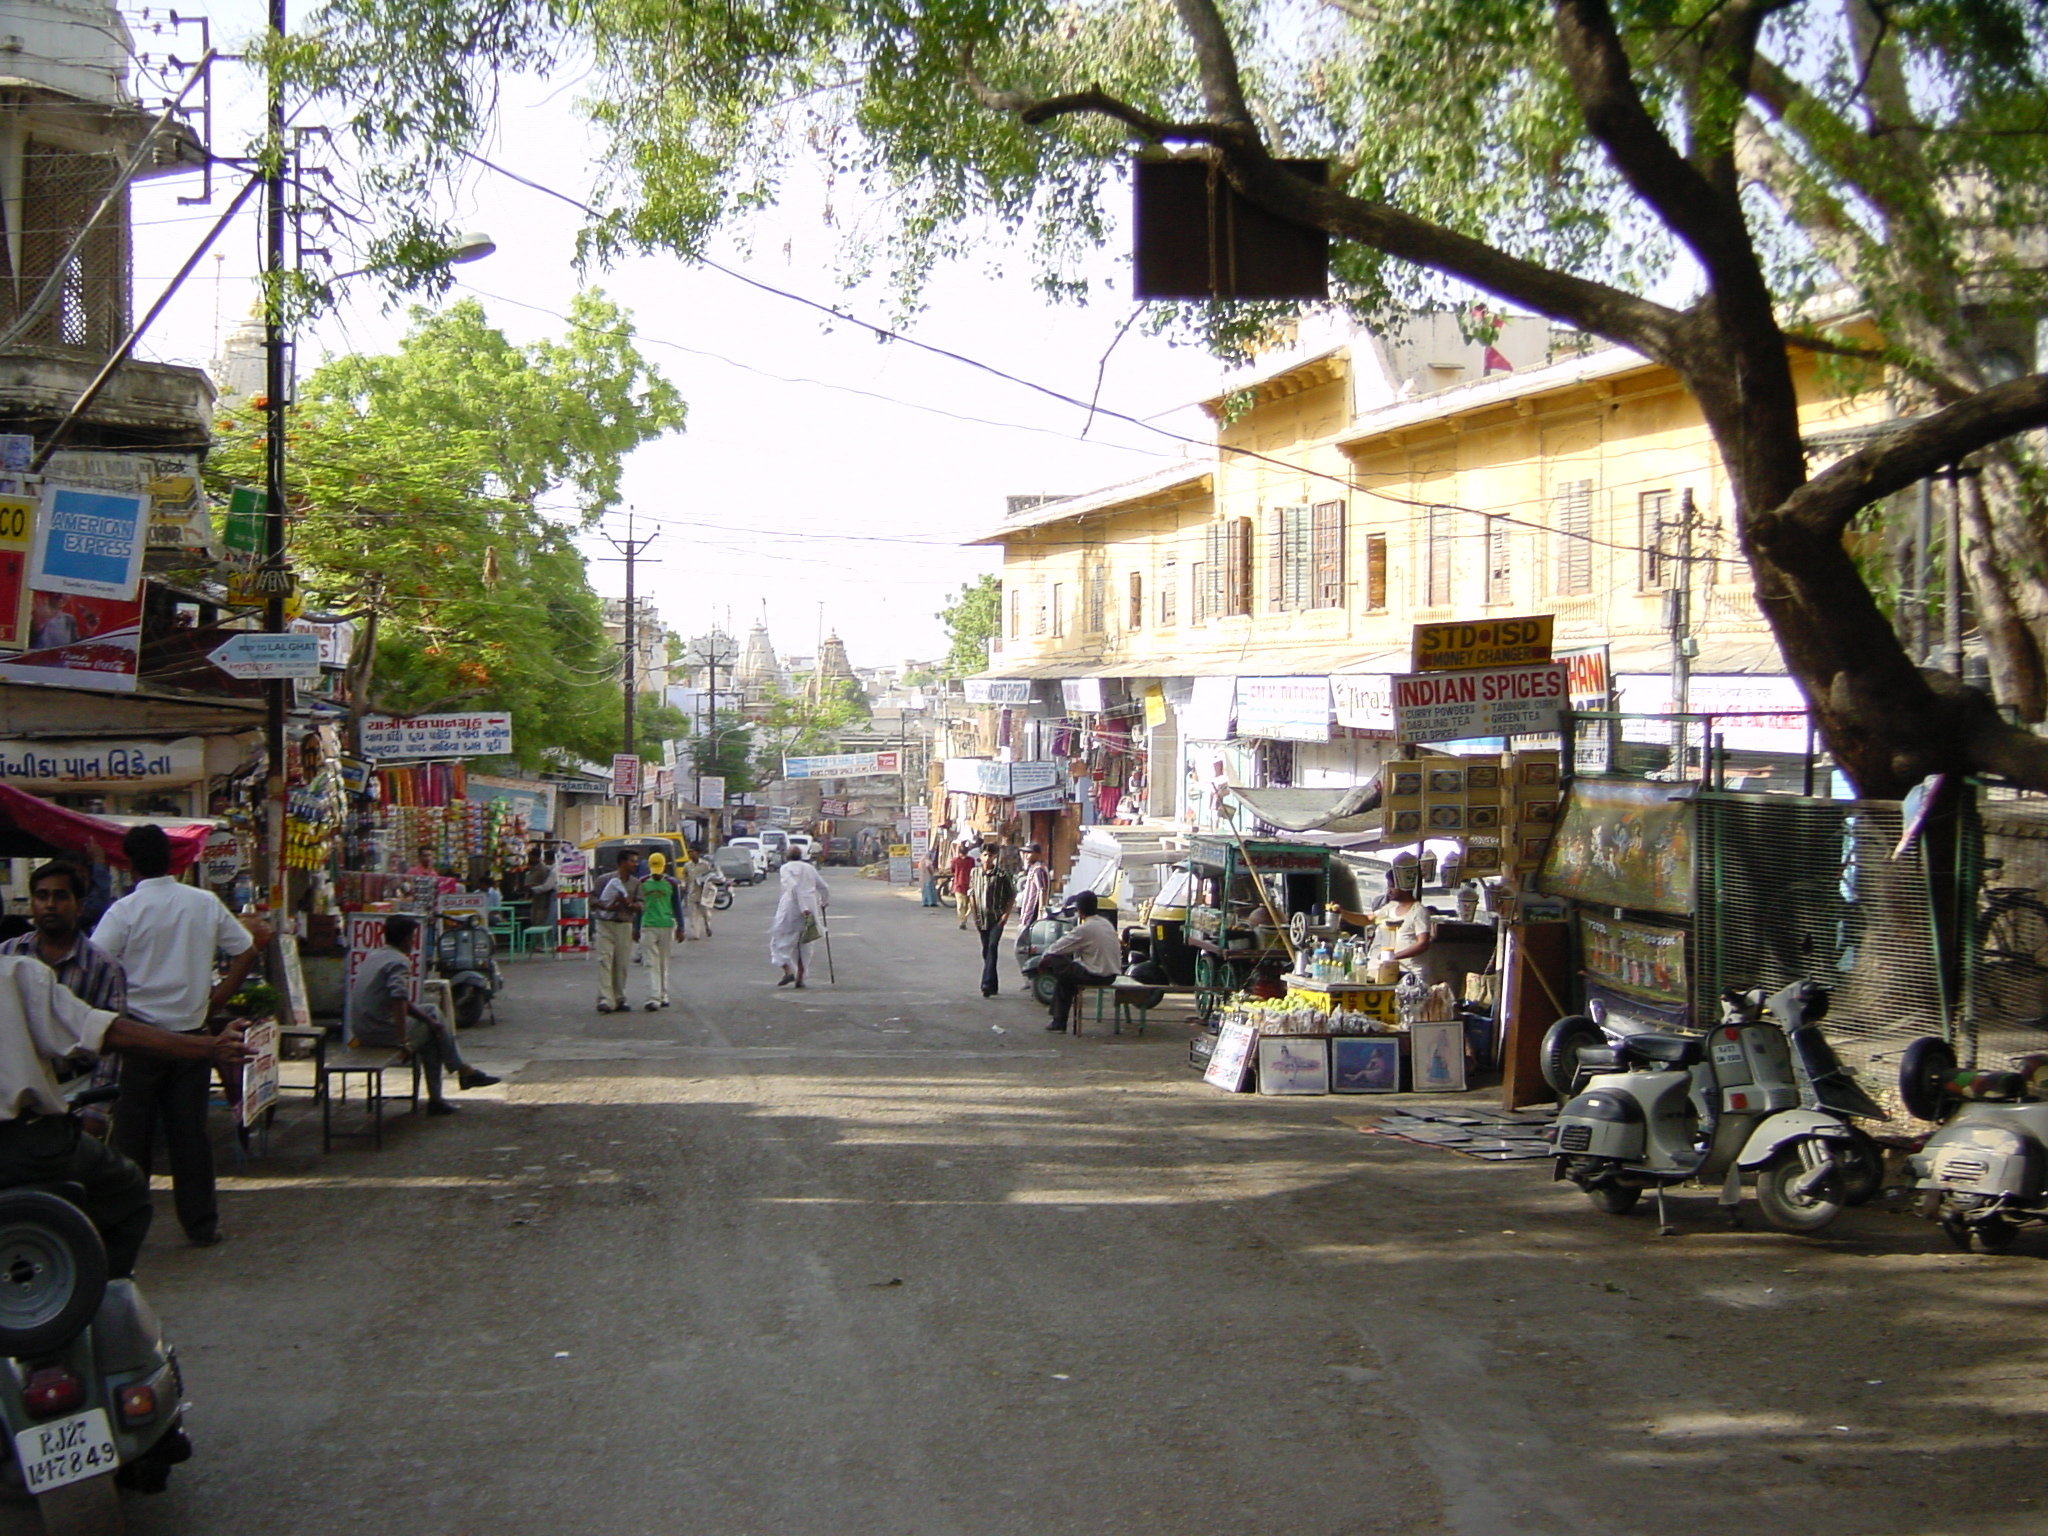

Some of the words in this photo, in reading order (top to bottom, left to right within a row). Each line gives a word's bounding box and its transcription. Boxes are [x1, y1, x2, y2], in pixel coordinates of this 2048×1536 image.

[51, 511, 135, 540] AMERICAN
[64, 533, 133, 558] EXPRESS
[1421, 625, 1477, 650] STD
[1493, 620, 1540, 646] ISD
[268, 642, 287, 651] LAL
[288, 642, 317, 651] GHAT
[1399, 675, 1476, 707] INDIAN
[1482, 671, 1561, 700] SPICES
[1452, 715, 1471, 727] TEA
[1522, 711, 1541, 722] TEA
[1408, 731, 1427, 742] TEA
[64, 758, 99, 778] પાન
